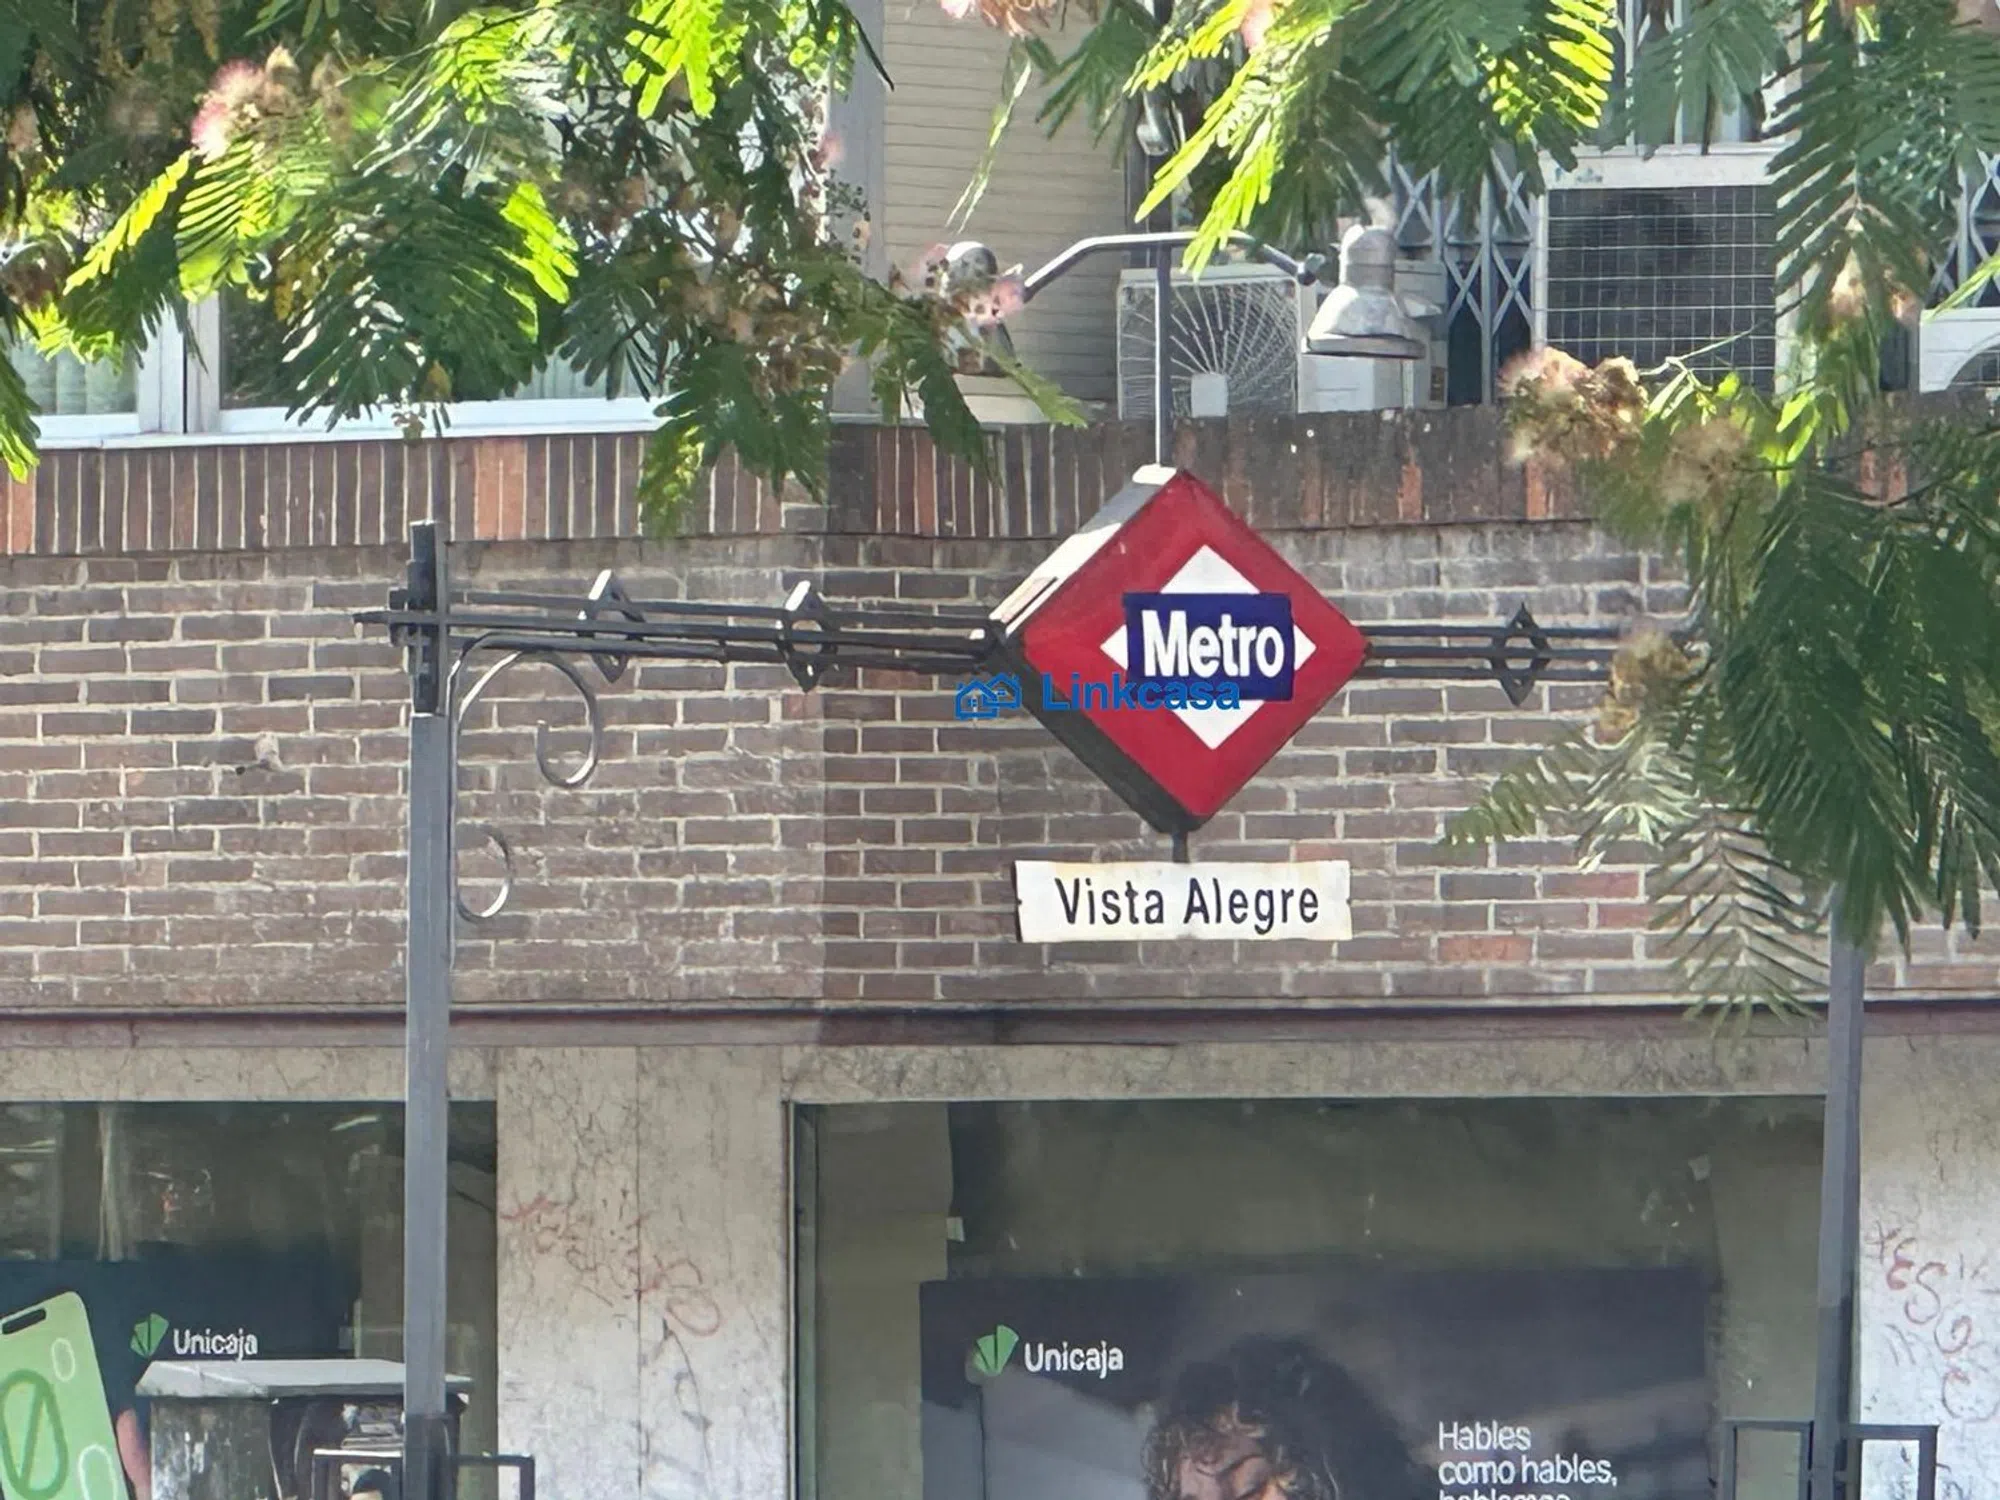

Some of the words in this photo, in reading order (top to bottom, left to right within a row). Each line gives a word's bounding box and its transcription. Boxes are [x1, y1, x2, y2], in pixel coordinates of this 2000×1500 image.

[1141, 609, 1285, 678] Metro
[1054, 877, 1164, 925] Vista
[1183, 877, 1319, 935] Alegre
[173, 1328, 258, 1360] Unicaja
[1024, 1340, 1124, 1379] Unicaja
[1438, 1420, 1531, 1450] Hables
[1438, 1460, 1516, 1485] como
[1521, 1453, 1617, 1487] hables,
